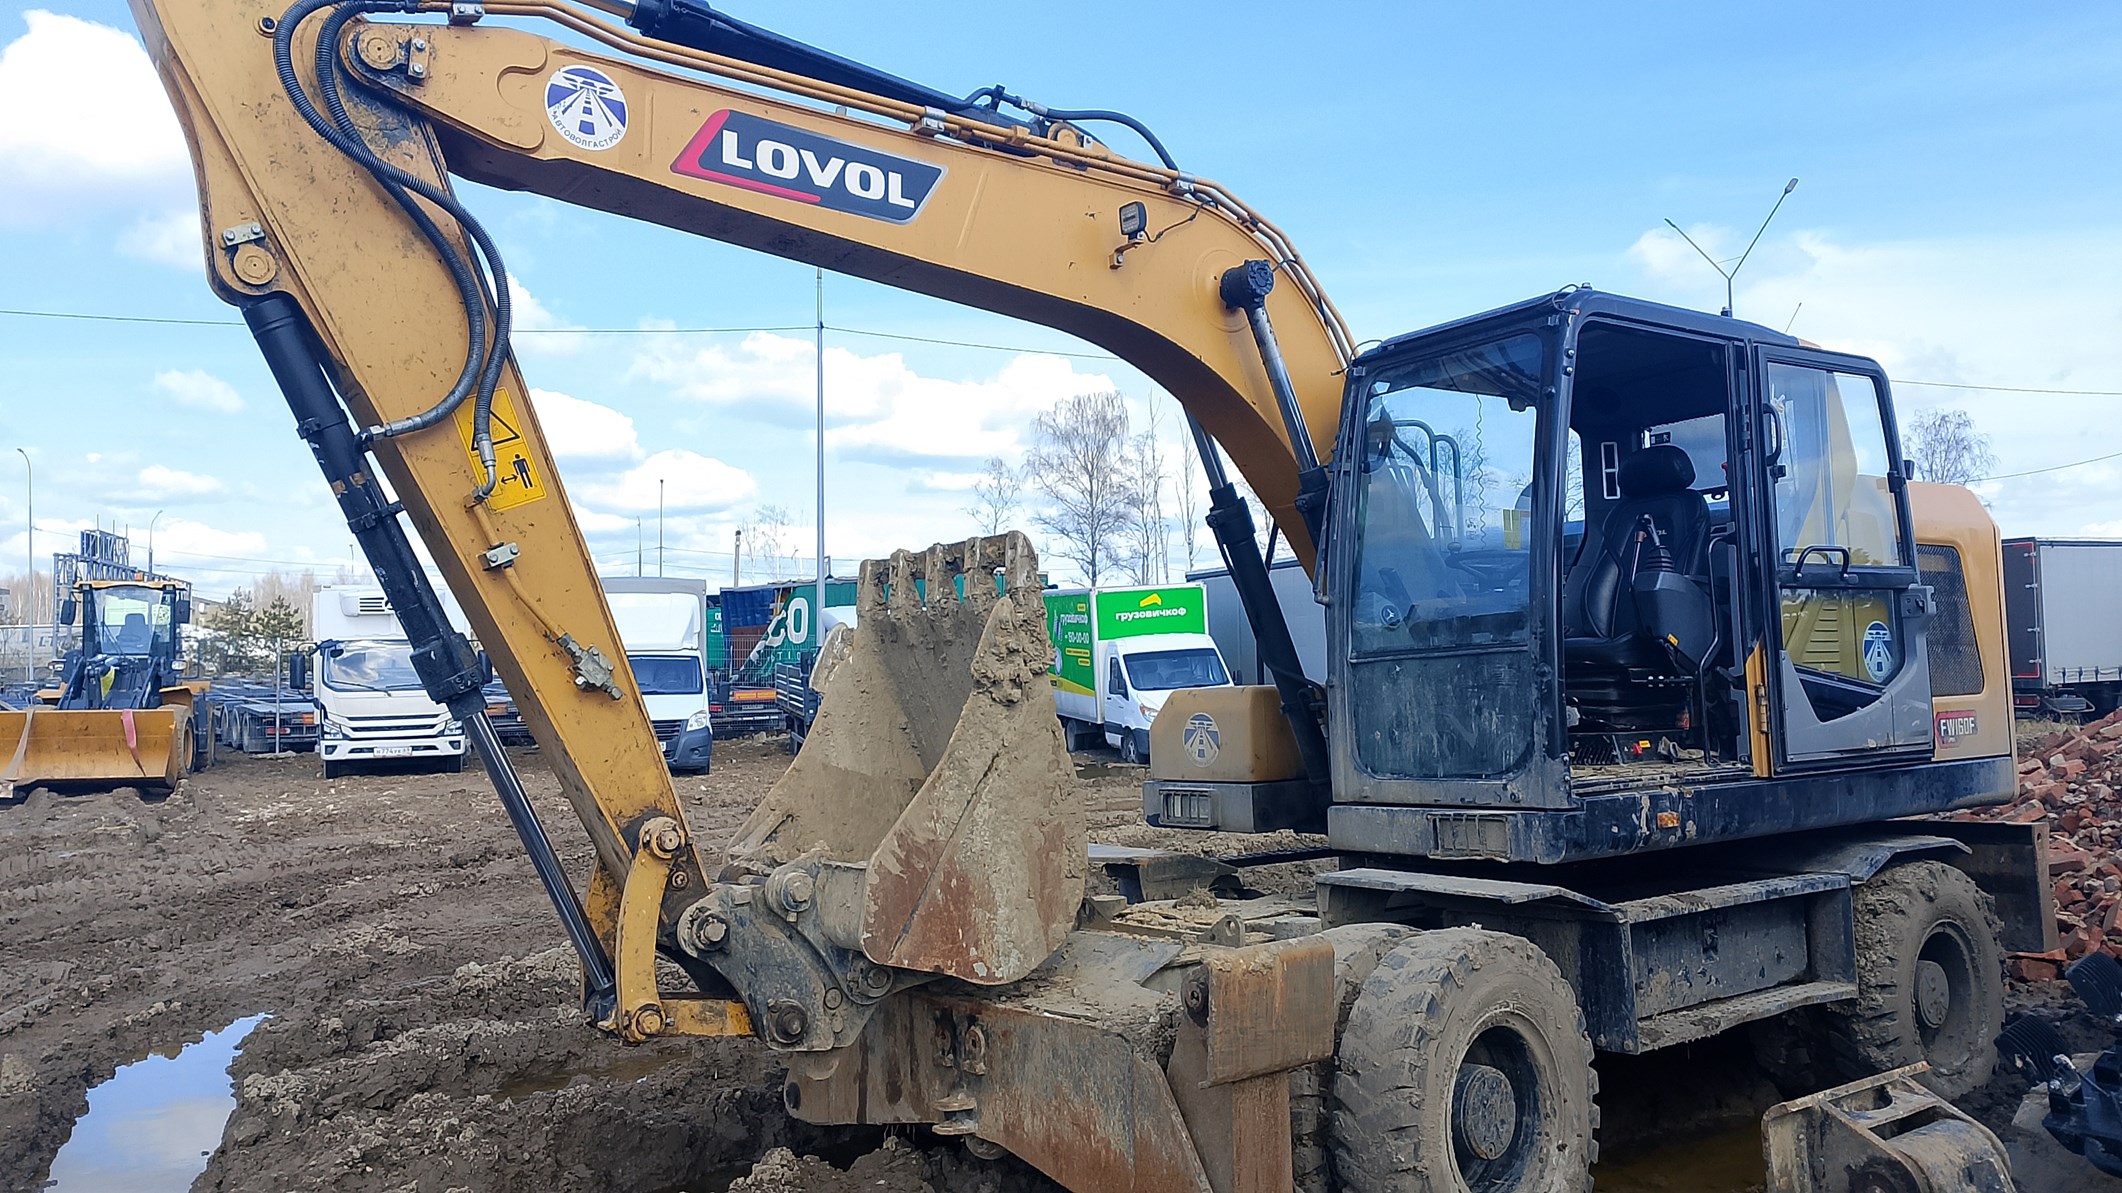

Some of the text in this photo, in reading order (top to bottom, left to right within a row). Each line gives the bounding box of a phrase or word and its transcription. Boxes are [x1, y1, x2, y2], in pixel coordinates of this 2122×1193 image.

[721, 129, 915, 209] LOVOL
[1115, 607, 1187, 622] грузовичкоф
[1940, 717, 1975, 737] FW160F
